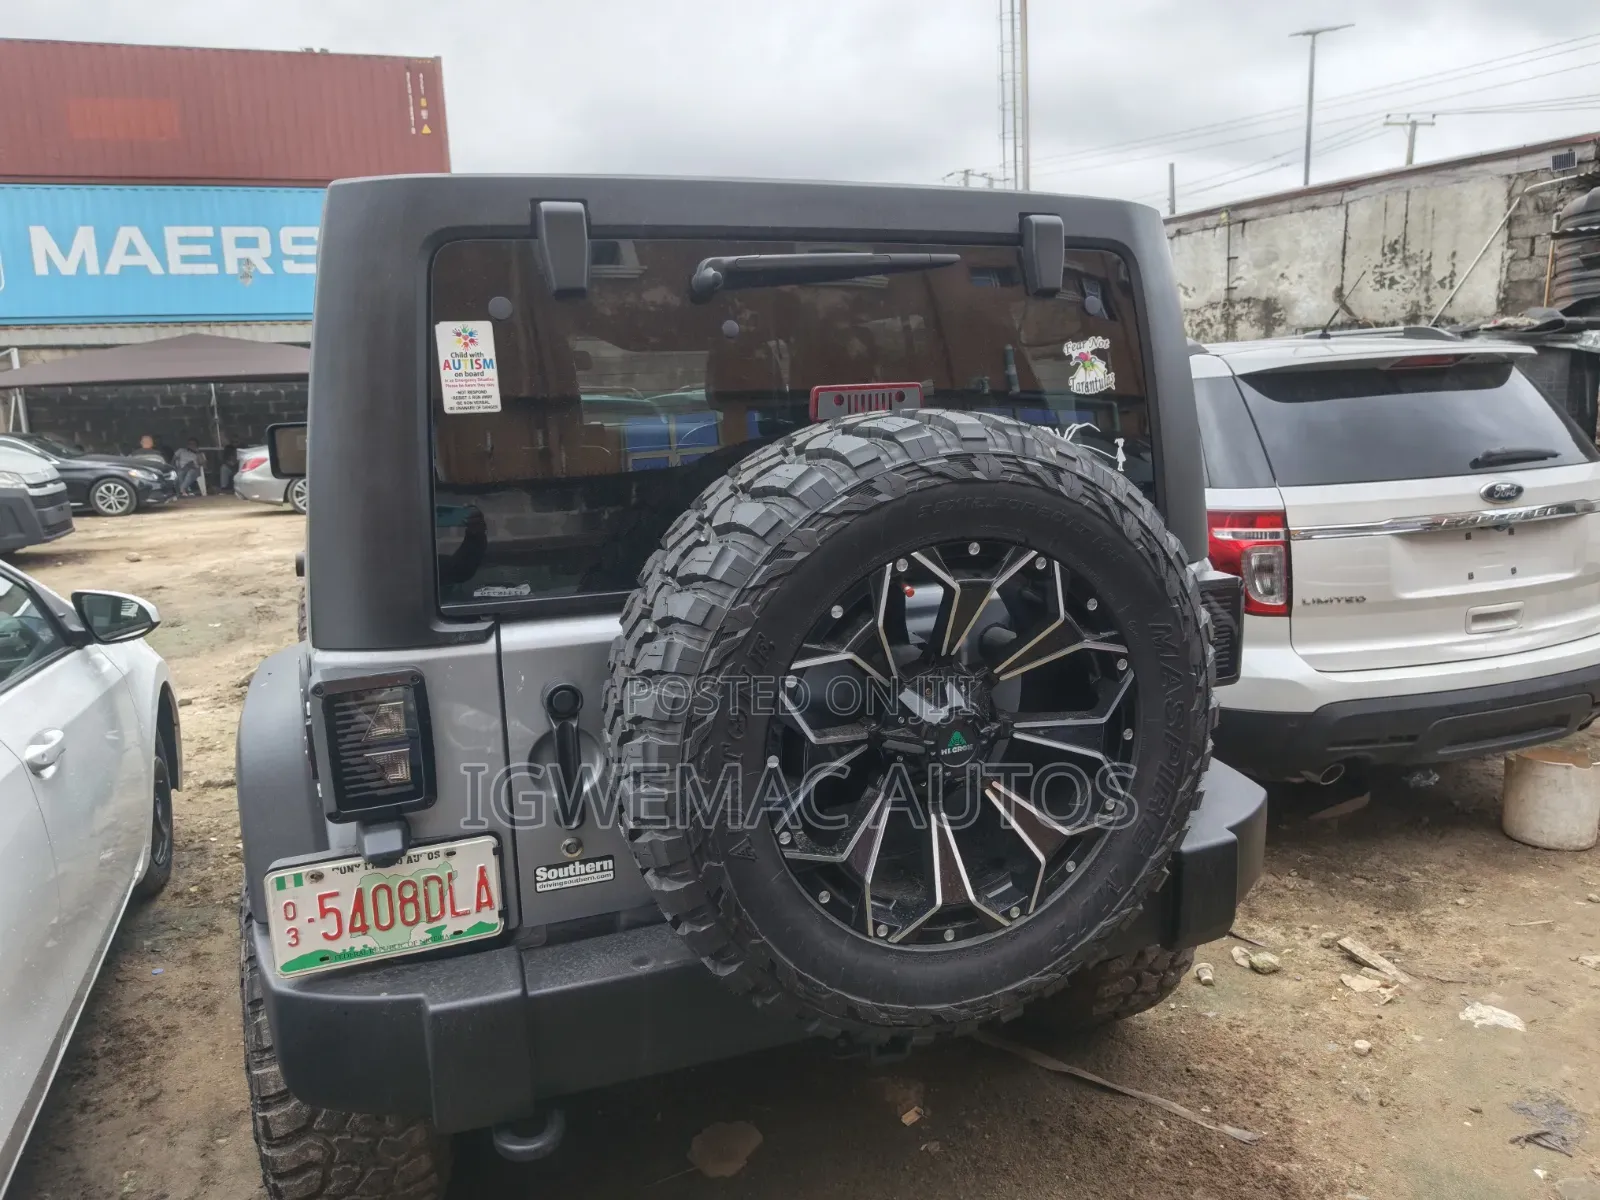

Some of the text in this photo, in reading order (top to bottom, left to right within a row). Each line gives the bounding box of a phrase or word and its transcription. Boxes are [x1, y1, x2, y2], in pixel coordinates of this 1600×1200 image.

[1065, 337, 1110, 354] Fear Not
[450, 351, 485, 359] Child with
[443, 358, 495, 371] AUTISM
[464, 370, 485, 378] board
[1069, 372, 1115, 393] Tarantulas
[1493, 483, 1517, 498] Ford
[1301, 595, 1367, 607] LIMITED
[535, 859, 614, 882] Southern
[538, 872, 613, 890] drivingsouthern.com
[334, 949, 369, 961] FEDERAL
